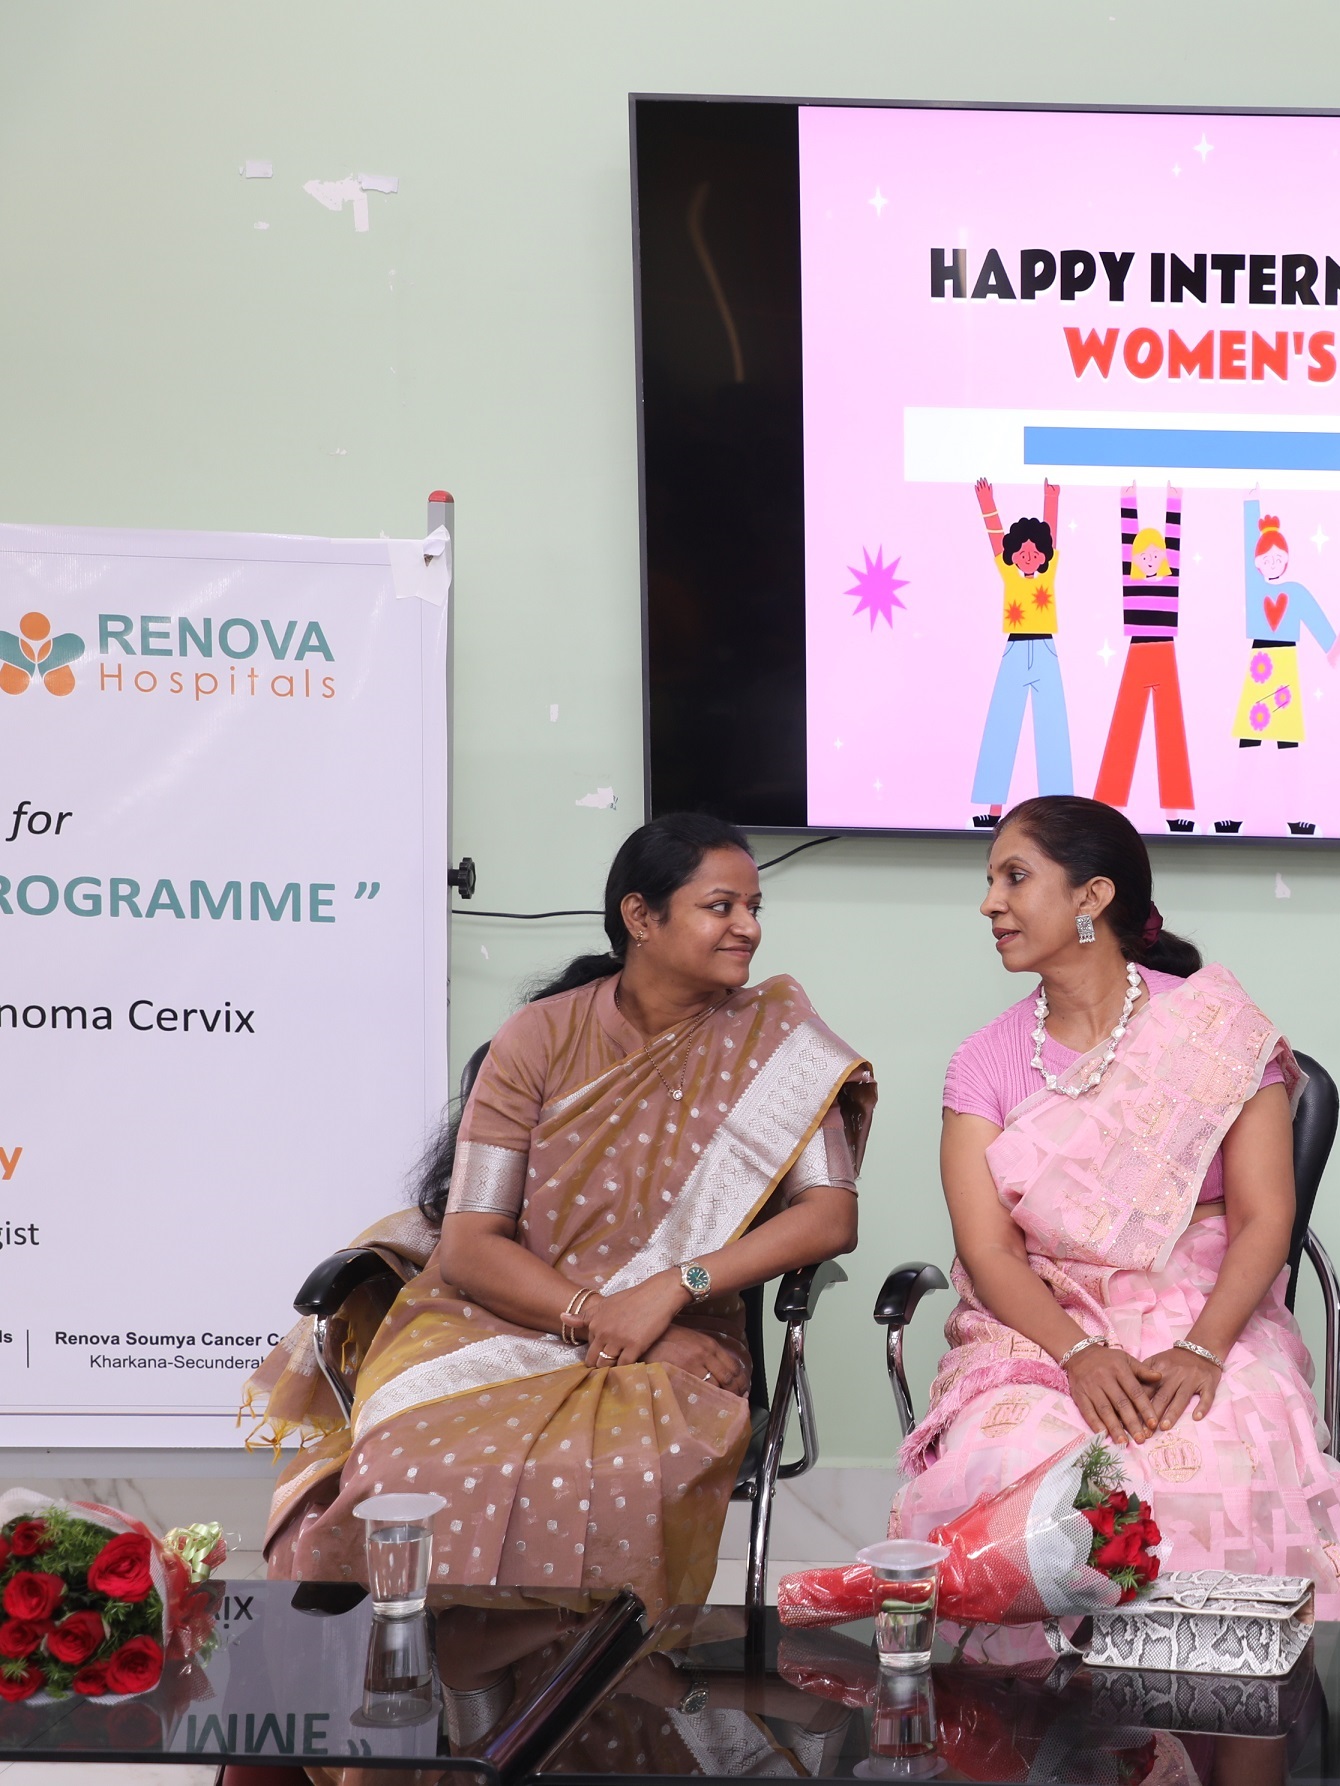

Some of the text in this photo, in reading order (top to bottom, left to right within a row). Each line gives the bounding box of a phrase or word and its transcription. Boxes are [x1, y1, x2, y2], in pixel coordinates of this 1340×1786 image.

[930, 248, 1135, 303] HAPPY
[1062, 326, 1338, 383] WOMEN'S
[98, 613, 335, 663] RENOVA
[100, 662, 336, 701] Hospitals
[5, 801, 73, 842] for
[128, 1000, 256, 1034] Cervix
[55, 1331, 284, 1349] Renova Soumya Cancer C
